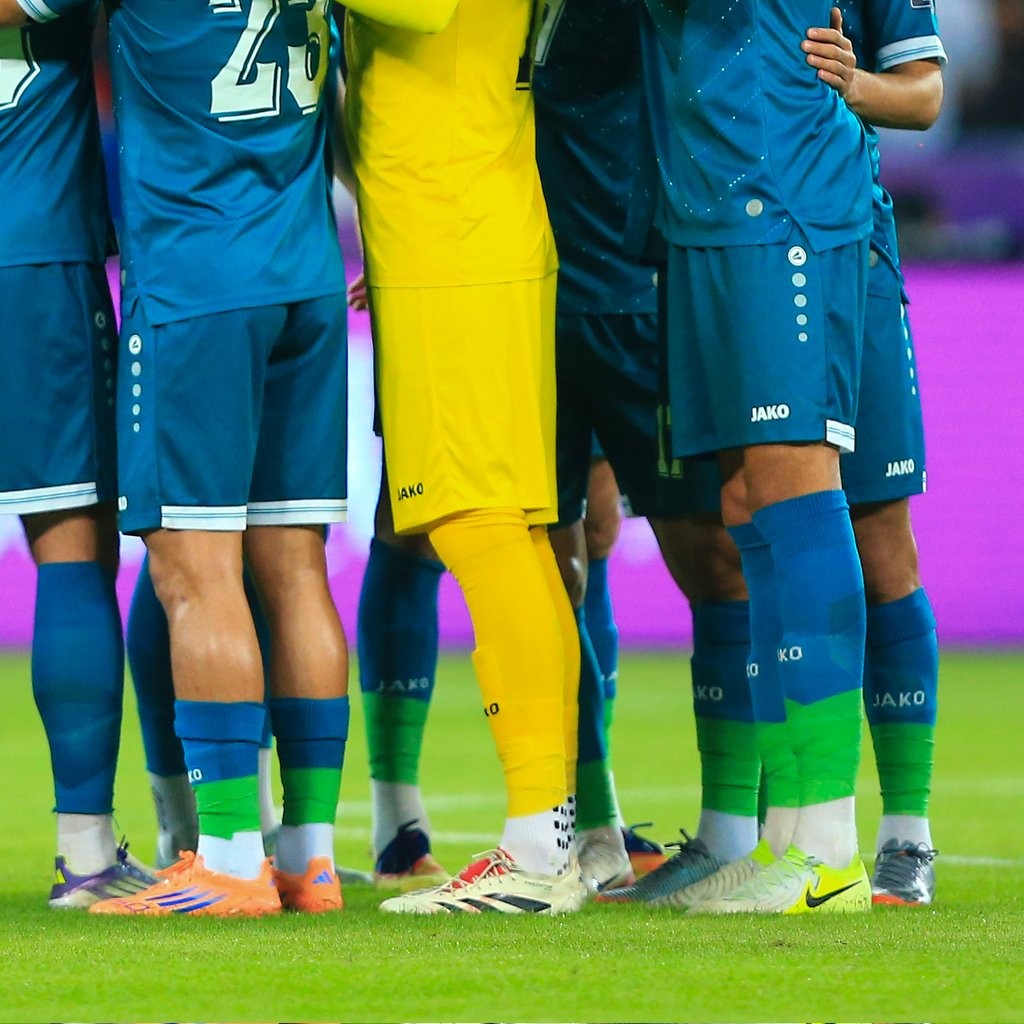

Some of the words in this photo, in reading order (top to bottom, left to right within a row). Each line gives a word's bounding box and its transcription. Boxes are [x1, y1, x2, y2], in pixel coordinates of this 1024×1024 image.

[751, 404, 790, 422] JAKO
[885, 458, 915, 477] JAKO
[397, 482, 424, 501] JAKO
[777, 646, 803, 662] KO
[695, 685, 723, 701] KO
[873, 690, 925, 707] JAKO
